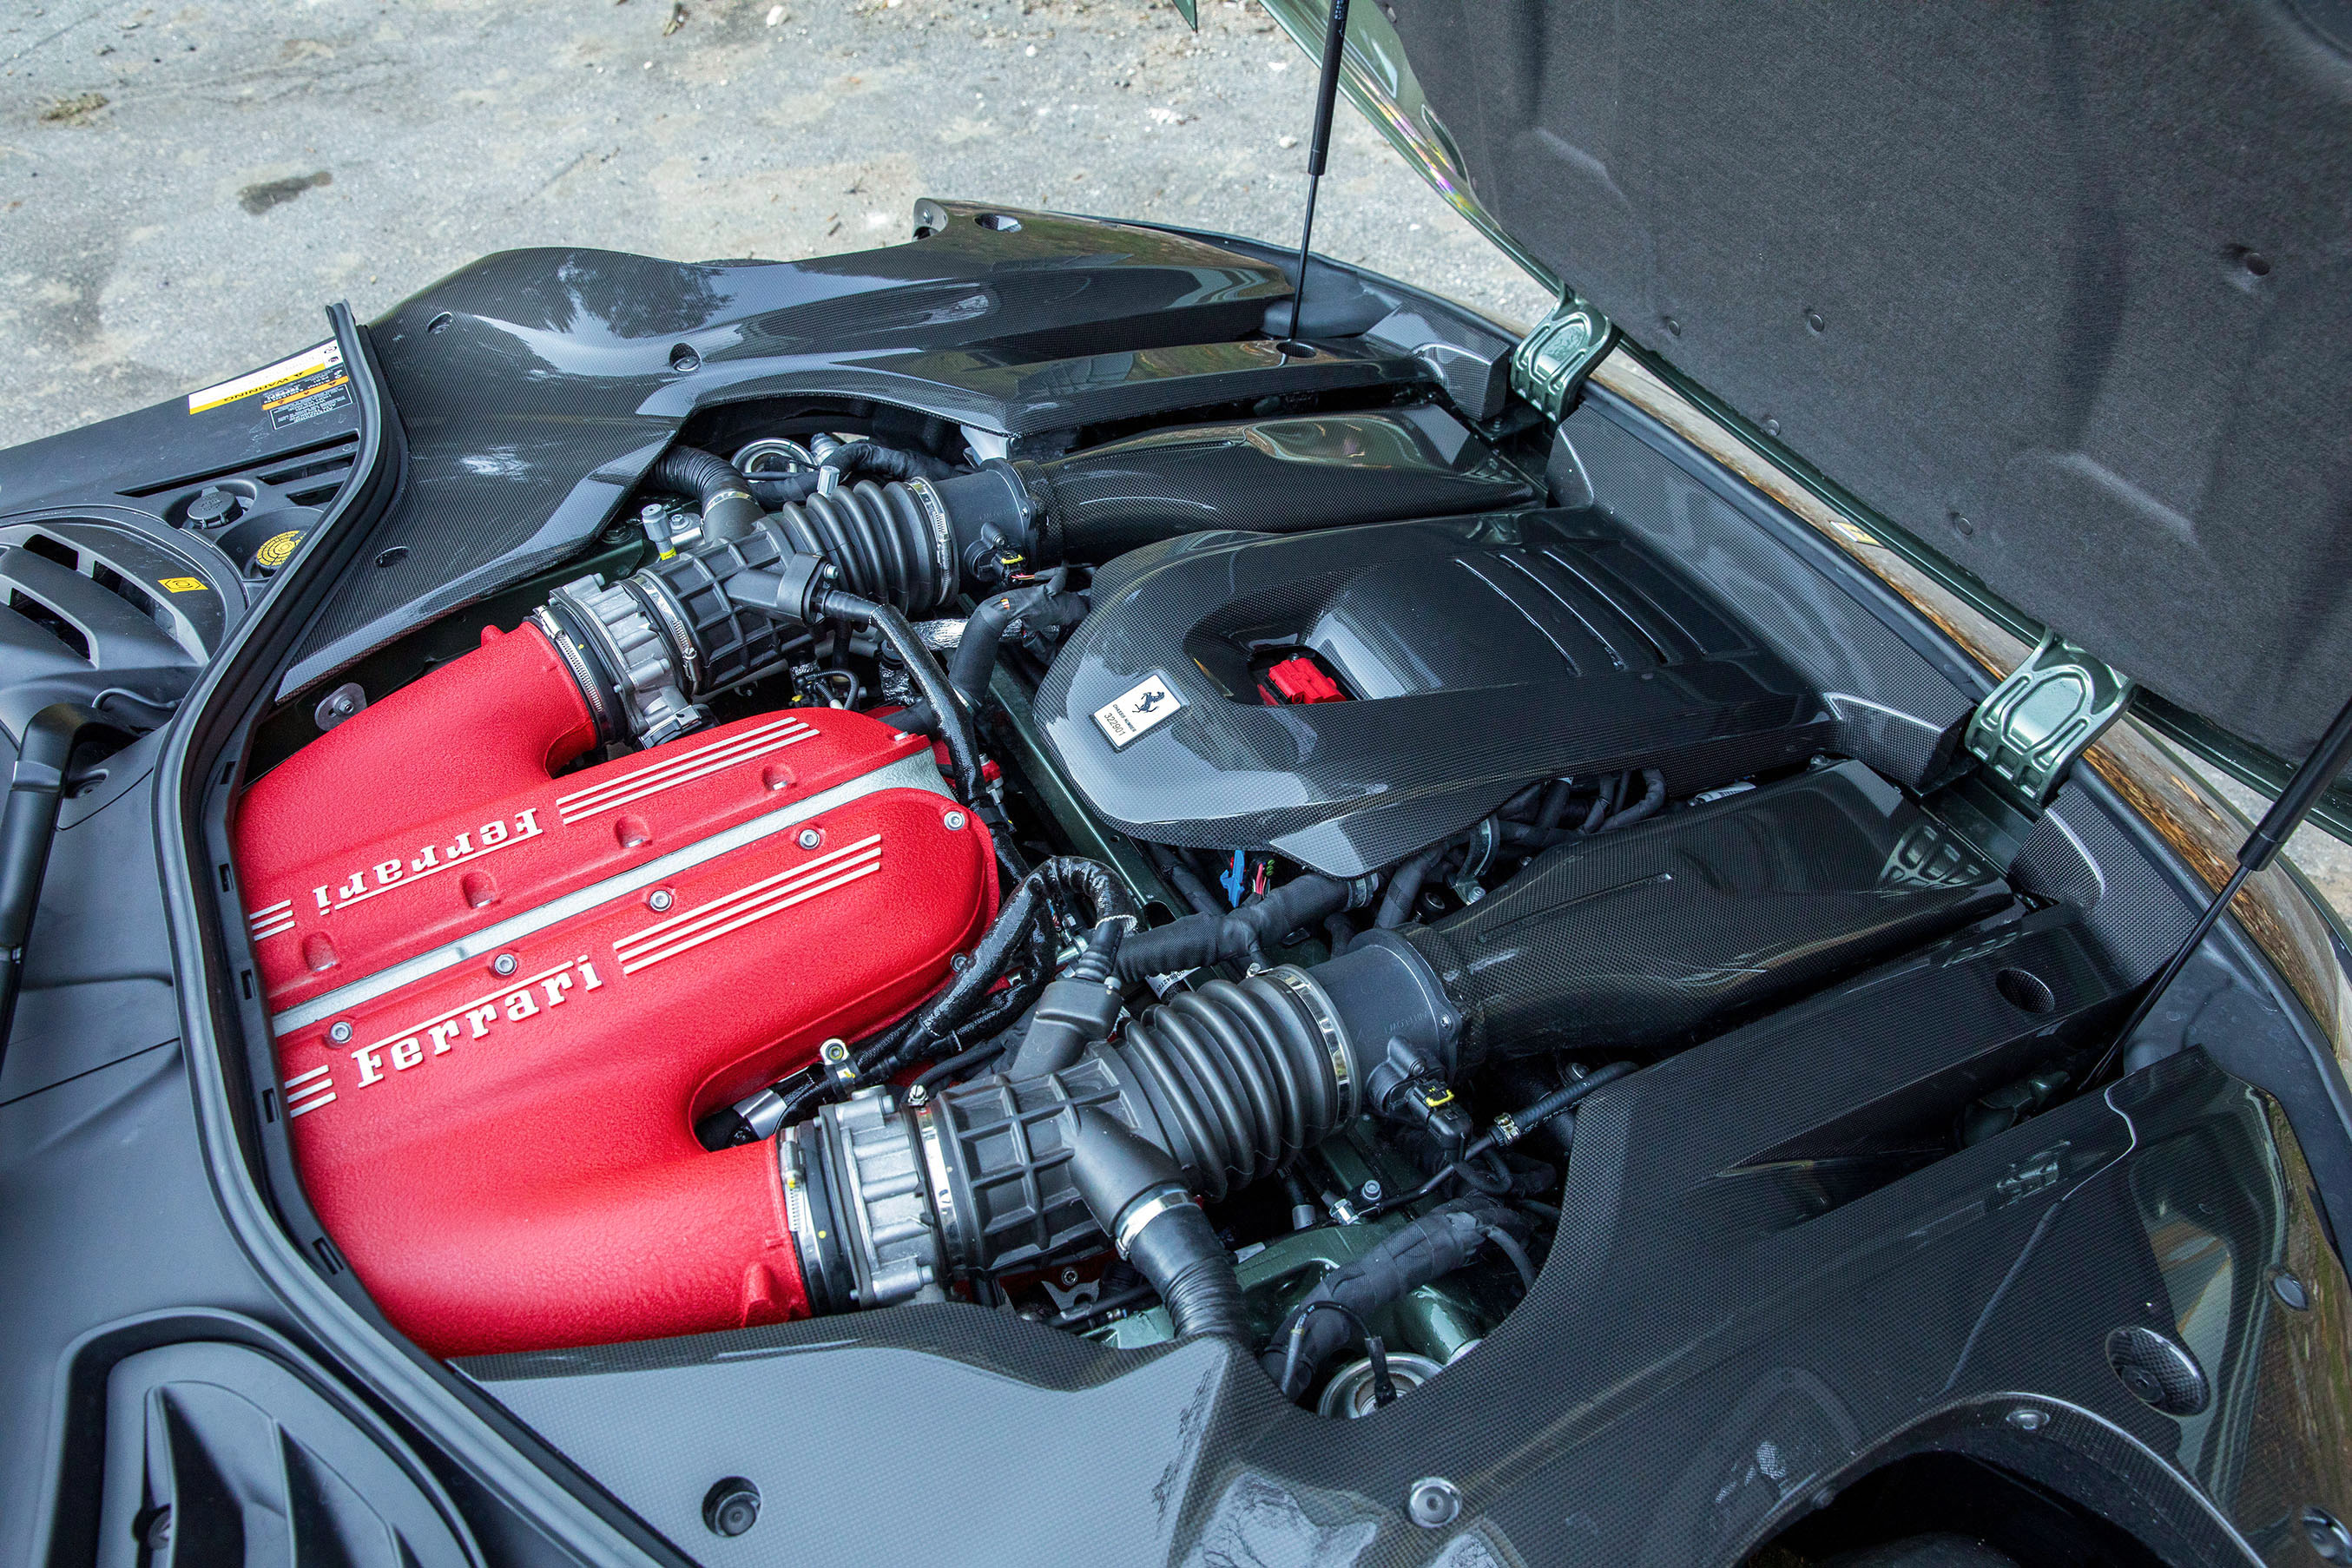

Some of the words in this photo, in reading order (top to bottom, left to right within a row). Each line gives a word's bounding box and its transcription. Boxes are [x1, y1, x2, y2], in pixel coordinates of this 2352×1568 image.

[224, 378, 289, 402] WARNING
[1104, 712, 1126, 736] 322901
[312, 807, 544, 916] Ferrari
[350, 954, 603, 1089] Ferrari
